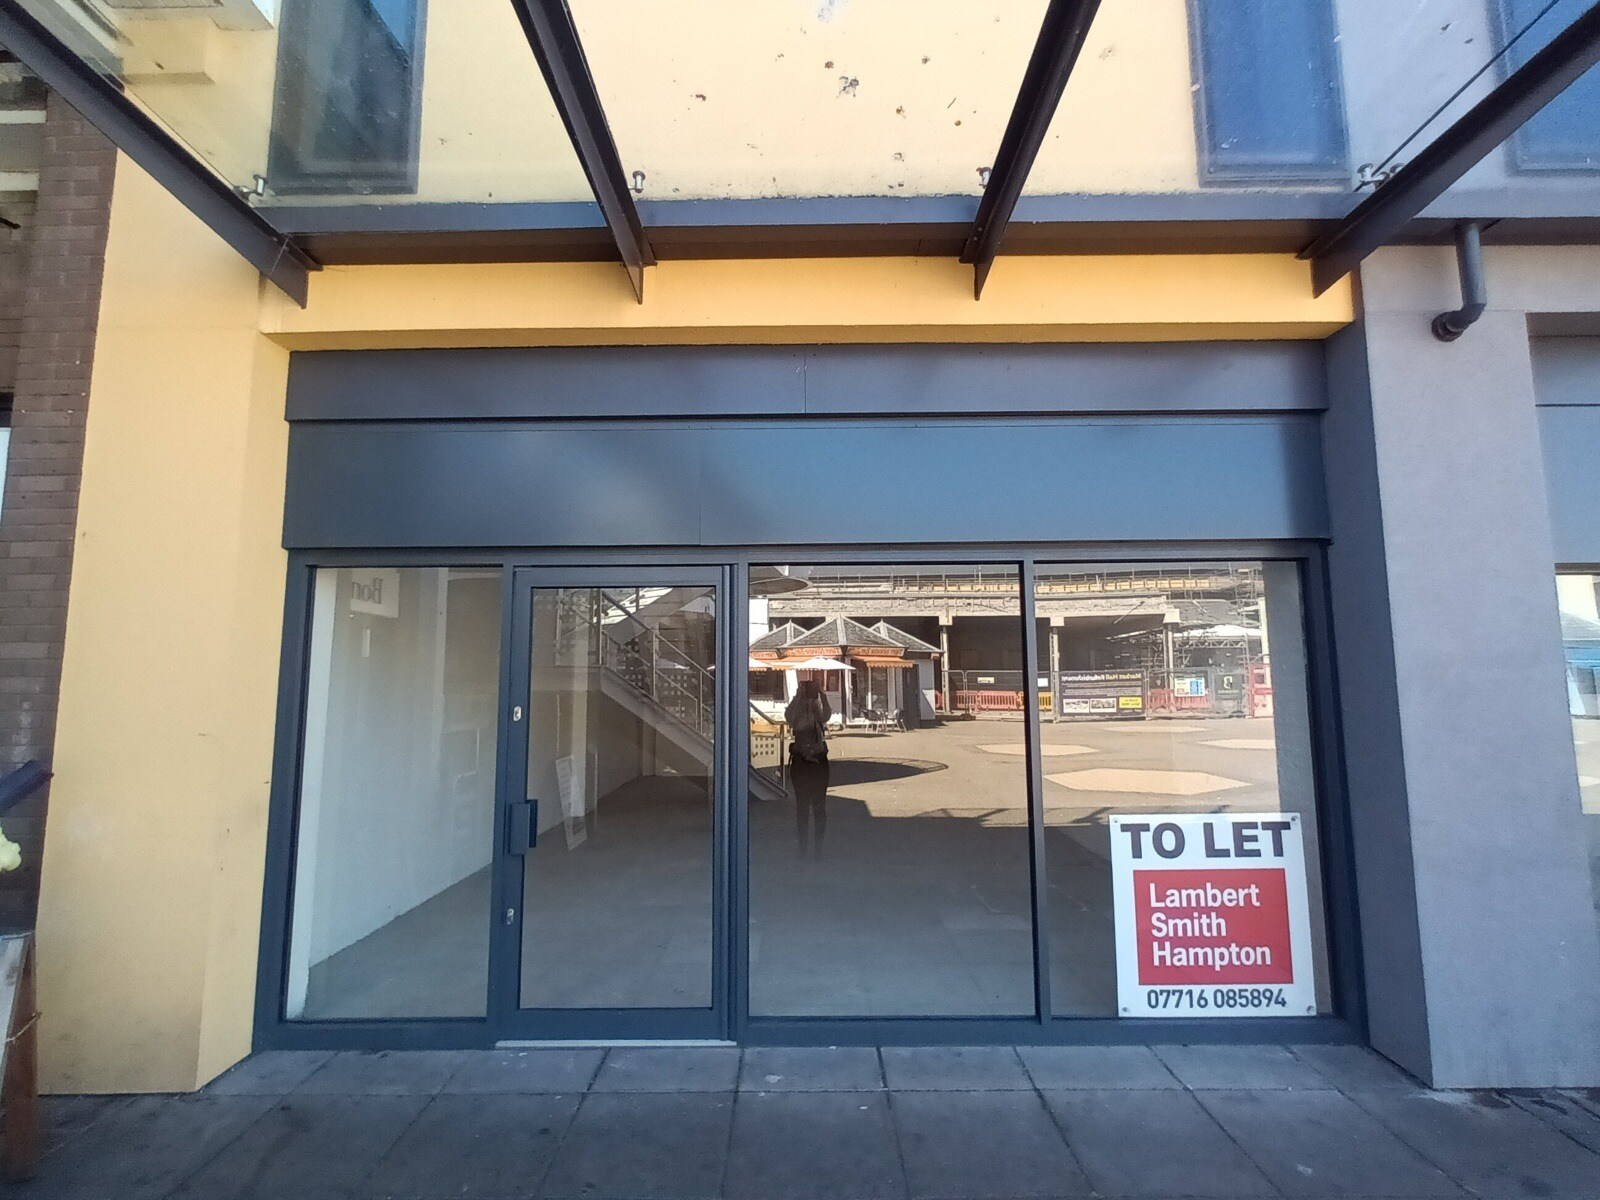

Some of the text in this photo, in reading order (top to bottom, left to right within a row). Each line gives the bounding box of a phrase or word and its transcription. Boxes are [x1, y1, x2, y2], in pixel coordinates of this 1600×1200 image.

[1120, 821, 1292, 859] TO LET
[1149, 882, 1261, 908] Lambert
[1151, 912, 1227, 938] Smith
[1152, 941, 1272, 972] Hampton
[1147, 988, 1287, 1009] 07716 085894
